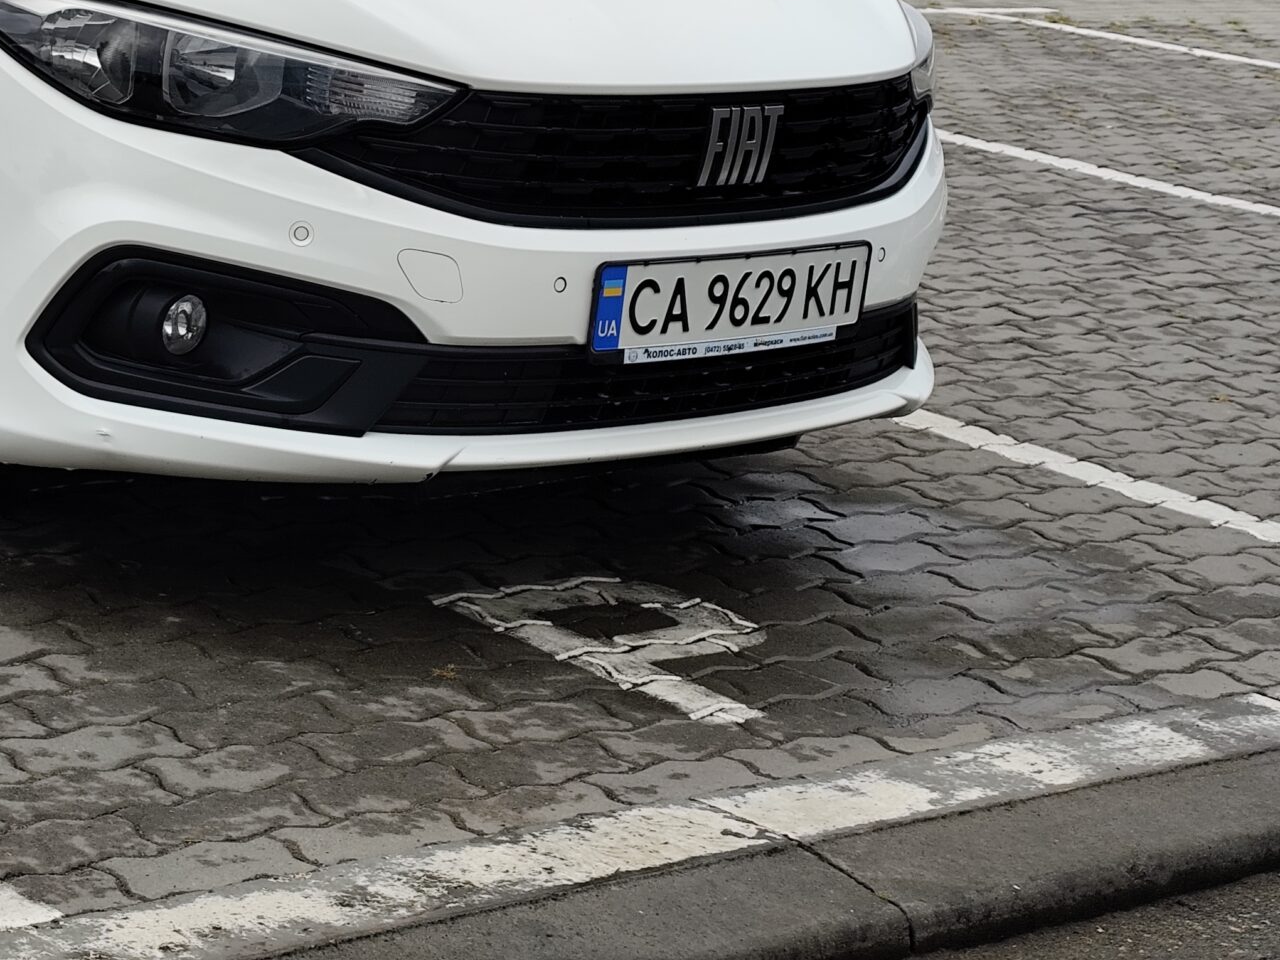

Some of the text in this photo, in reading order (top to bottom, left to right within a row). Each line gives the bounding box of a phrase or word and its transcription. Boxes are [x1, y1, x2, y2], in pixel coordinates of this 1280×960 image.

[697, 105, 784, 187] FIAT
[628, 259, 858, 335] CA 9629 KH
[598, 320, 618, 338] UA
[646, 346, 698, 359] КОЛОС-АВТО
